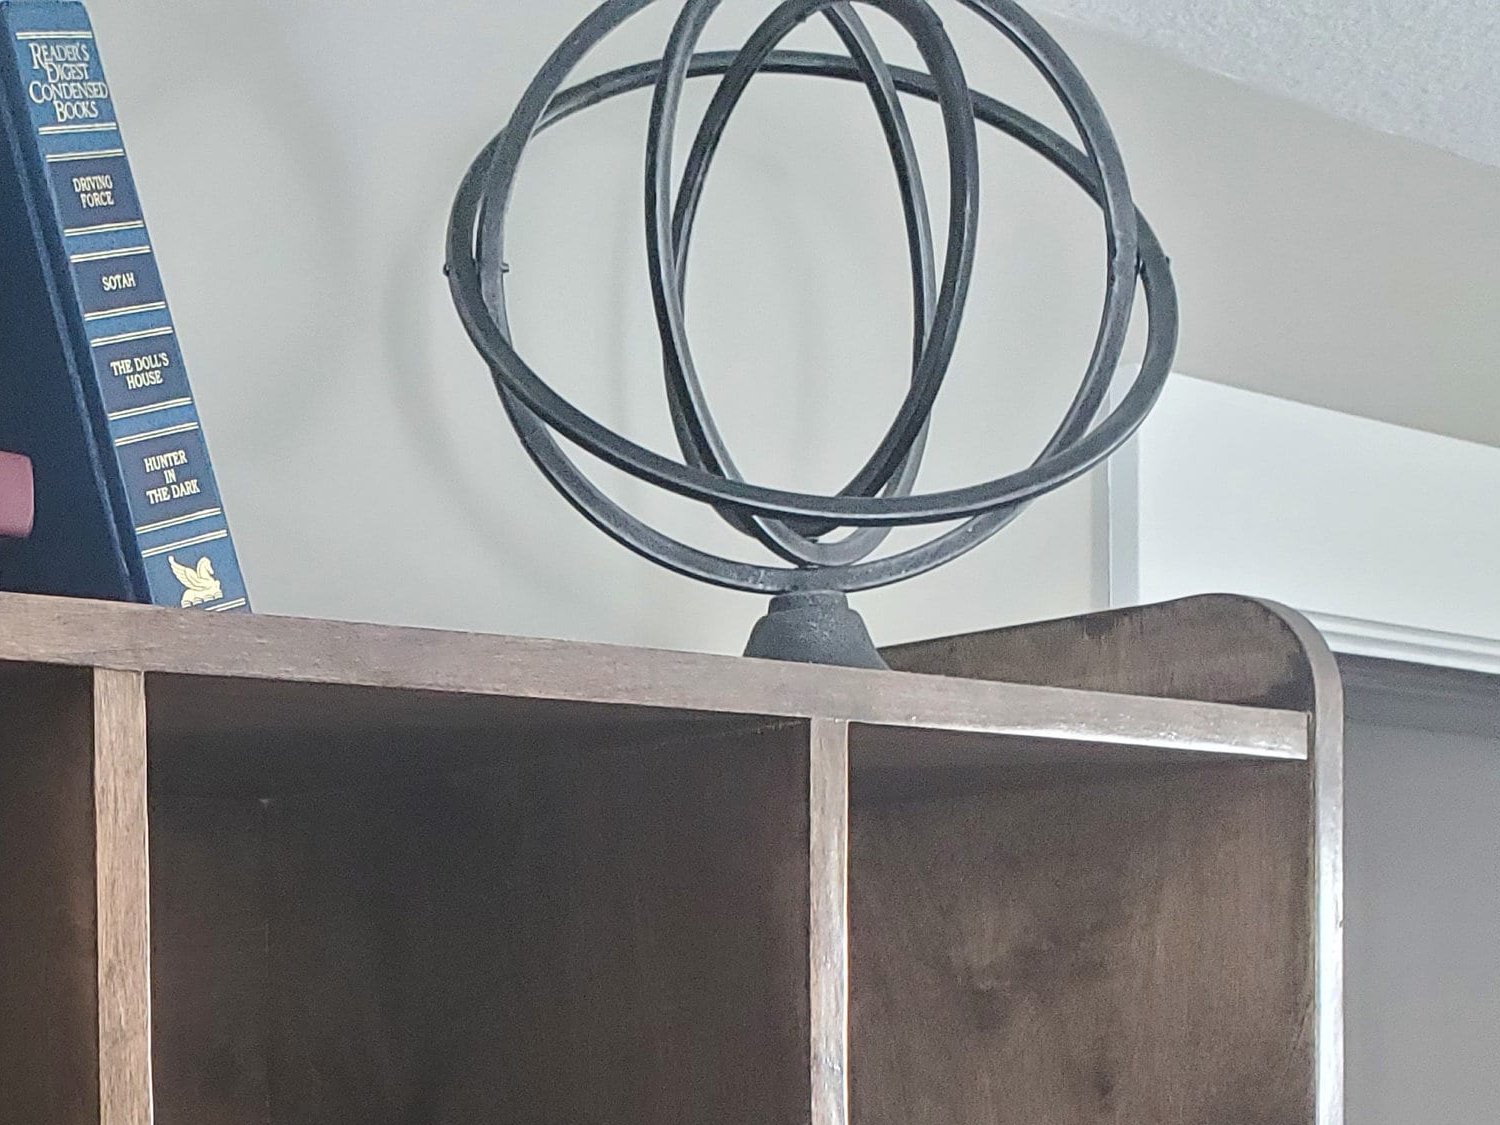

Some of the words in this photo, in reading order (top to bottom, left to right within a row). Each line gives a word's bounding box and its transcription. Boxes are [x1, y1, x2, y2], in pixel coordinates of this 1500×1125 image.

[28, 43, 89, 69] READER'S
[45, 62, 88, 83] DIGEST
[29, 81, 108, 103] CONDENSED
[53, 101, 98, 122] BOOKS
[73, 175, 113, 192] DRIVING
[80, 191, 114, 208] FORCE
[102, 272, 136, 291] SOTAH
[110, 360, 133, 376] THE
[135, 352, 169, 372] DOLL'S
[126, 370, 163, 389] HOUSE
[143, 450, 188, 472] HUNTER
[164, 469, 177, 483] IN
[146, 485, 171, 504] THE
[172, 479, 201, 498] DARK
